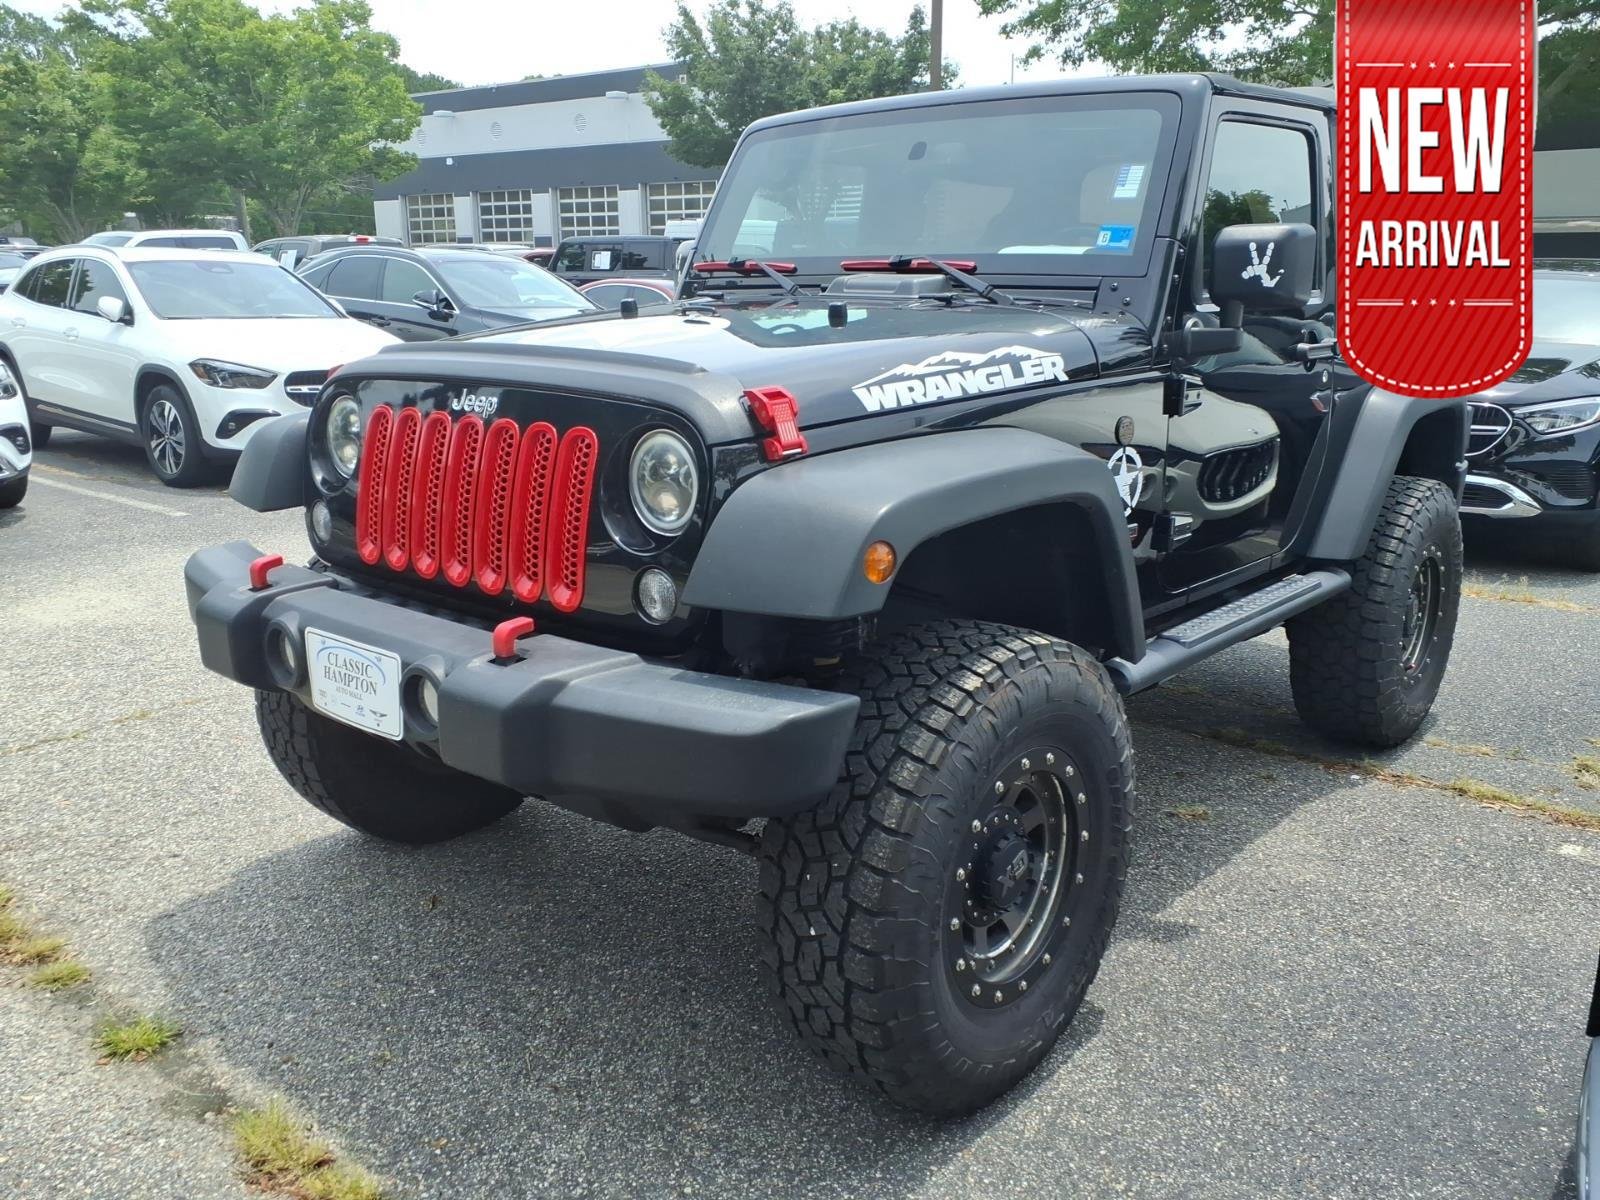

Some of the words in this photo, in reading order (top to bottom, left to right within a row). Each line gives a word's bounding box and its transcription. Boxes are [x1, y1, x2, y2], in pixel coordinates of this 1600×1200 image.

[852, 355, 1069, 412] WRANGLER
[451, 388, 498, 419] Jeep
[323, 665, 378, 696] HAMPTON
[327, 651, 374, 679] CLASSIC
